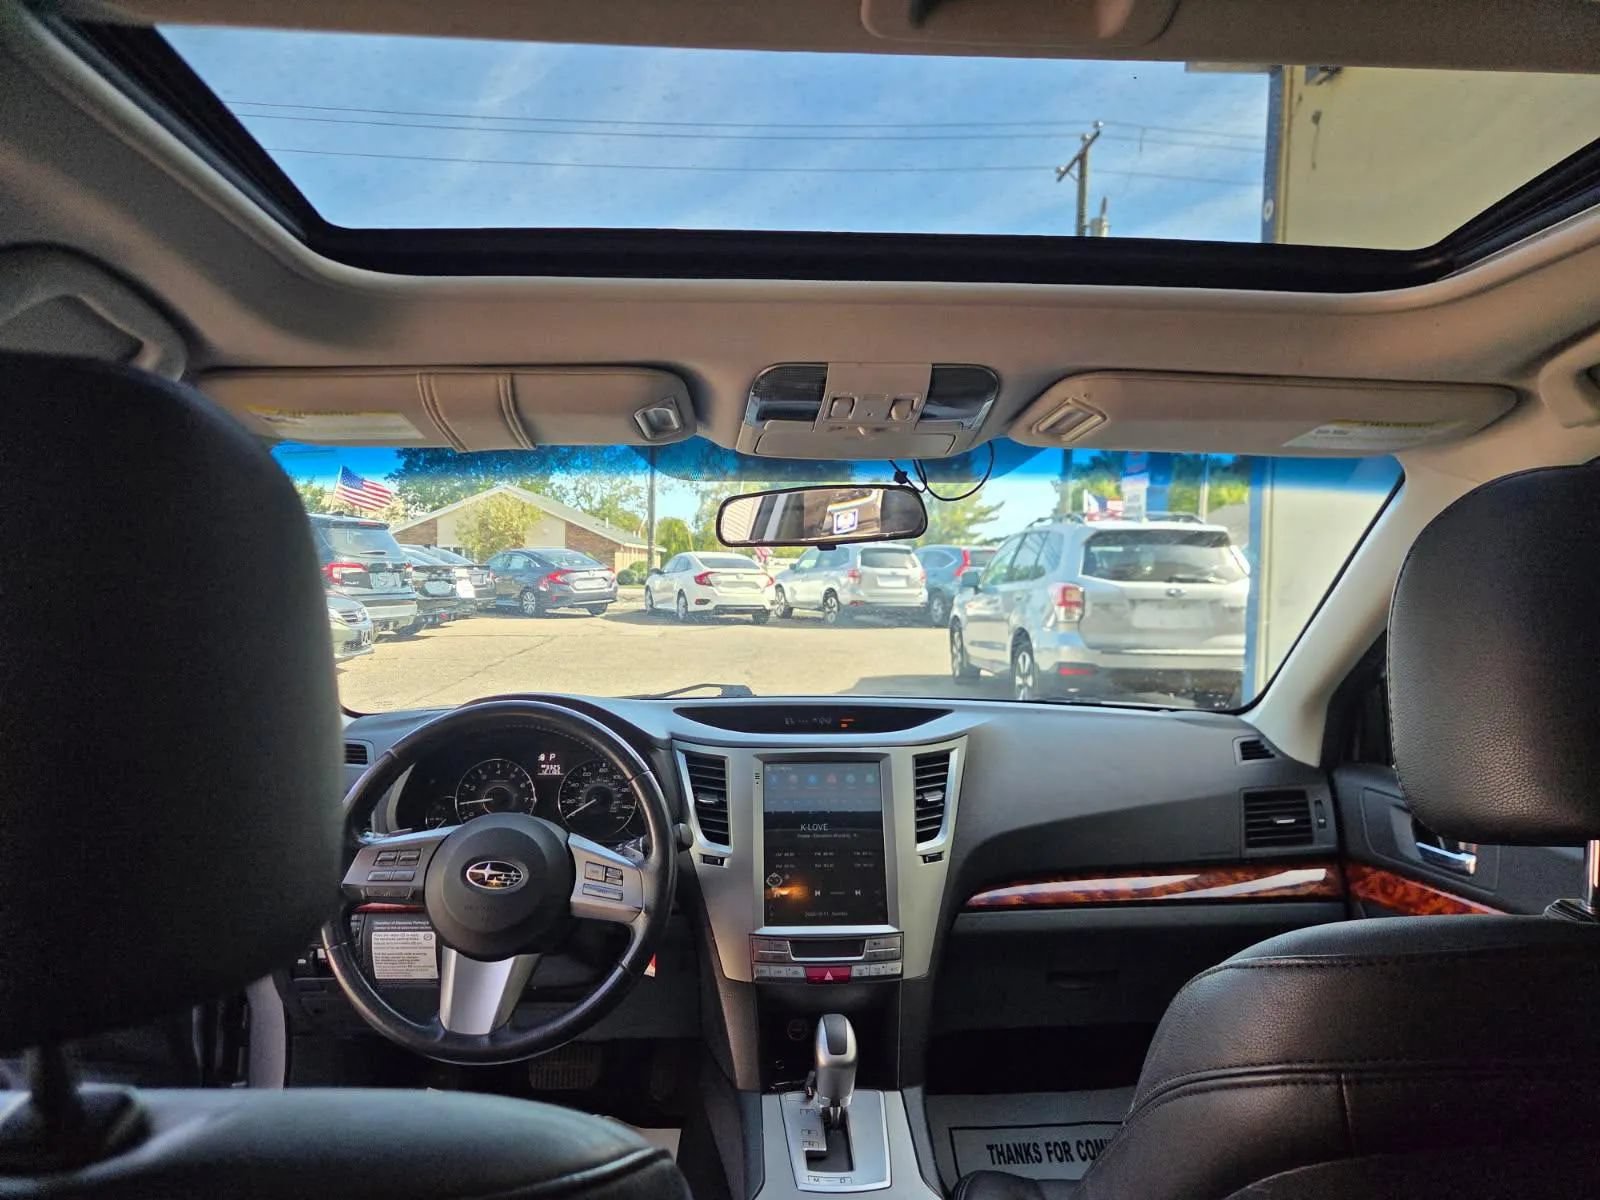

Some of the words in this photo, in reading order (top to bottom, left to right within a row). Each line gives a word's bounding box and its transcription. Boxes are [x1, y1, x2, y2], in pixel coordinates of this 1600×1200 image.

[800, 823, 829, 832] K-LOVE
[986, 1143, 1043, 1166] THANKS
[1045, 1140, 1076, 1164] FOR
[1078, 1138, 1113, 1162] COM
